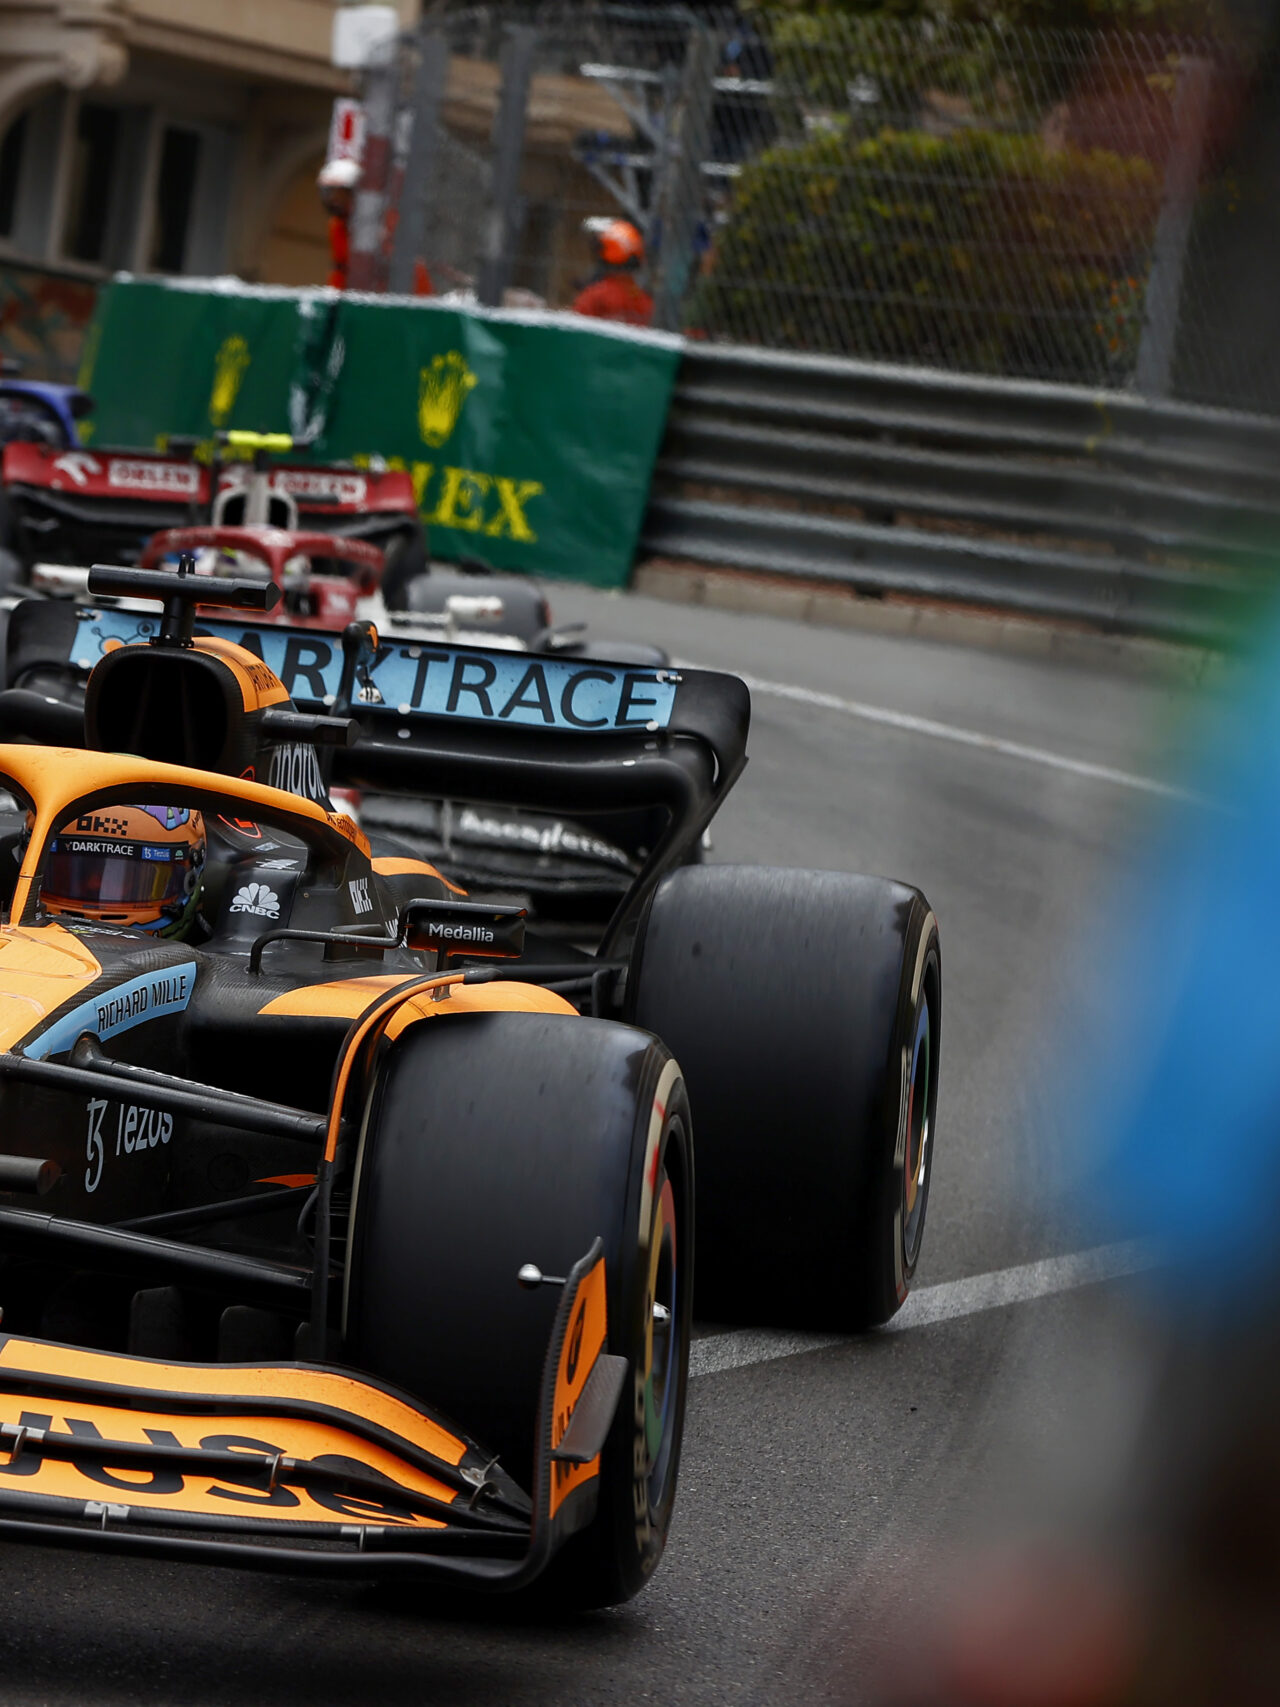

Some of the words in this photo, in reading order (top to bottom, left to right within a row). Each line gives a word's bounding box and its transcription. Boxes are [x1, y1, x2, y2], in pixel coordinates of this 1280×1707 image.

[117, 461, 193, 486] ORLEN
[352, 453, 544, 543] LEX
[196, 625, 663, 729] RKTRACE
[76, 816, 128, 836] OKX
[72, 841, 134, 856] DARKTRACE
[229, 904, 280, 920] CNBC
[428, 922, 495, 942] Medallia
[97, 987, 148, 1034] RICHARD
[151, 975, 187, 1006] MILLE
